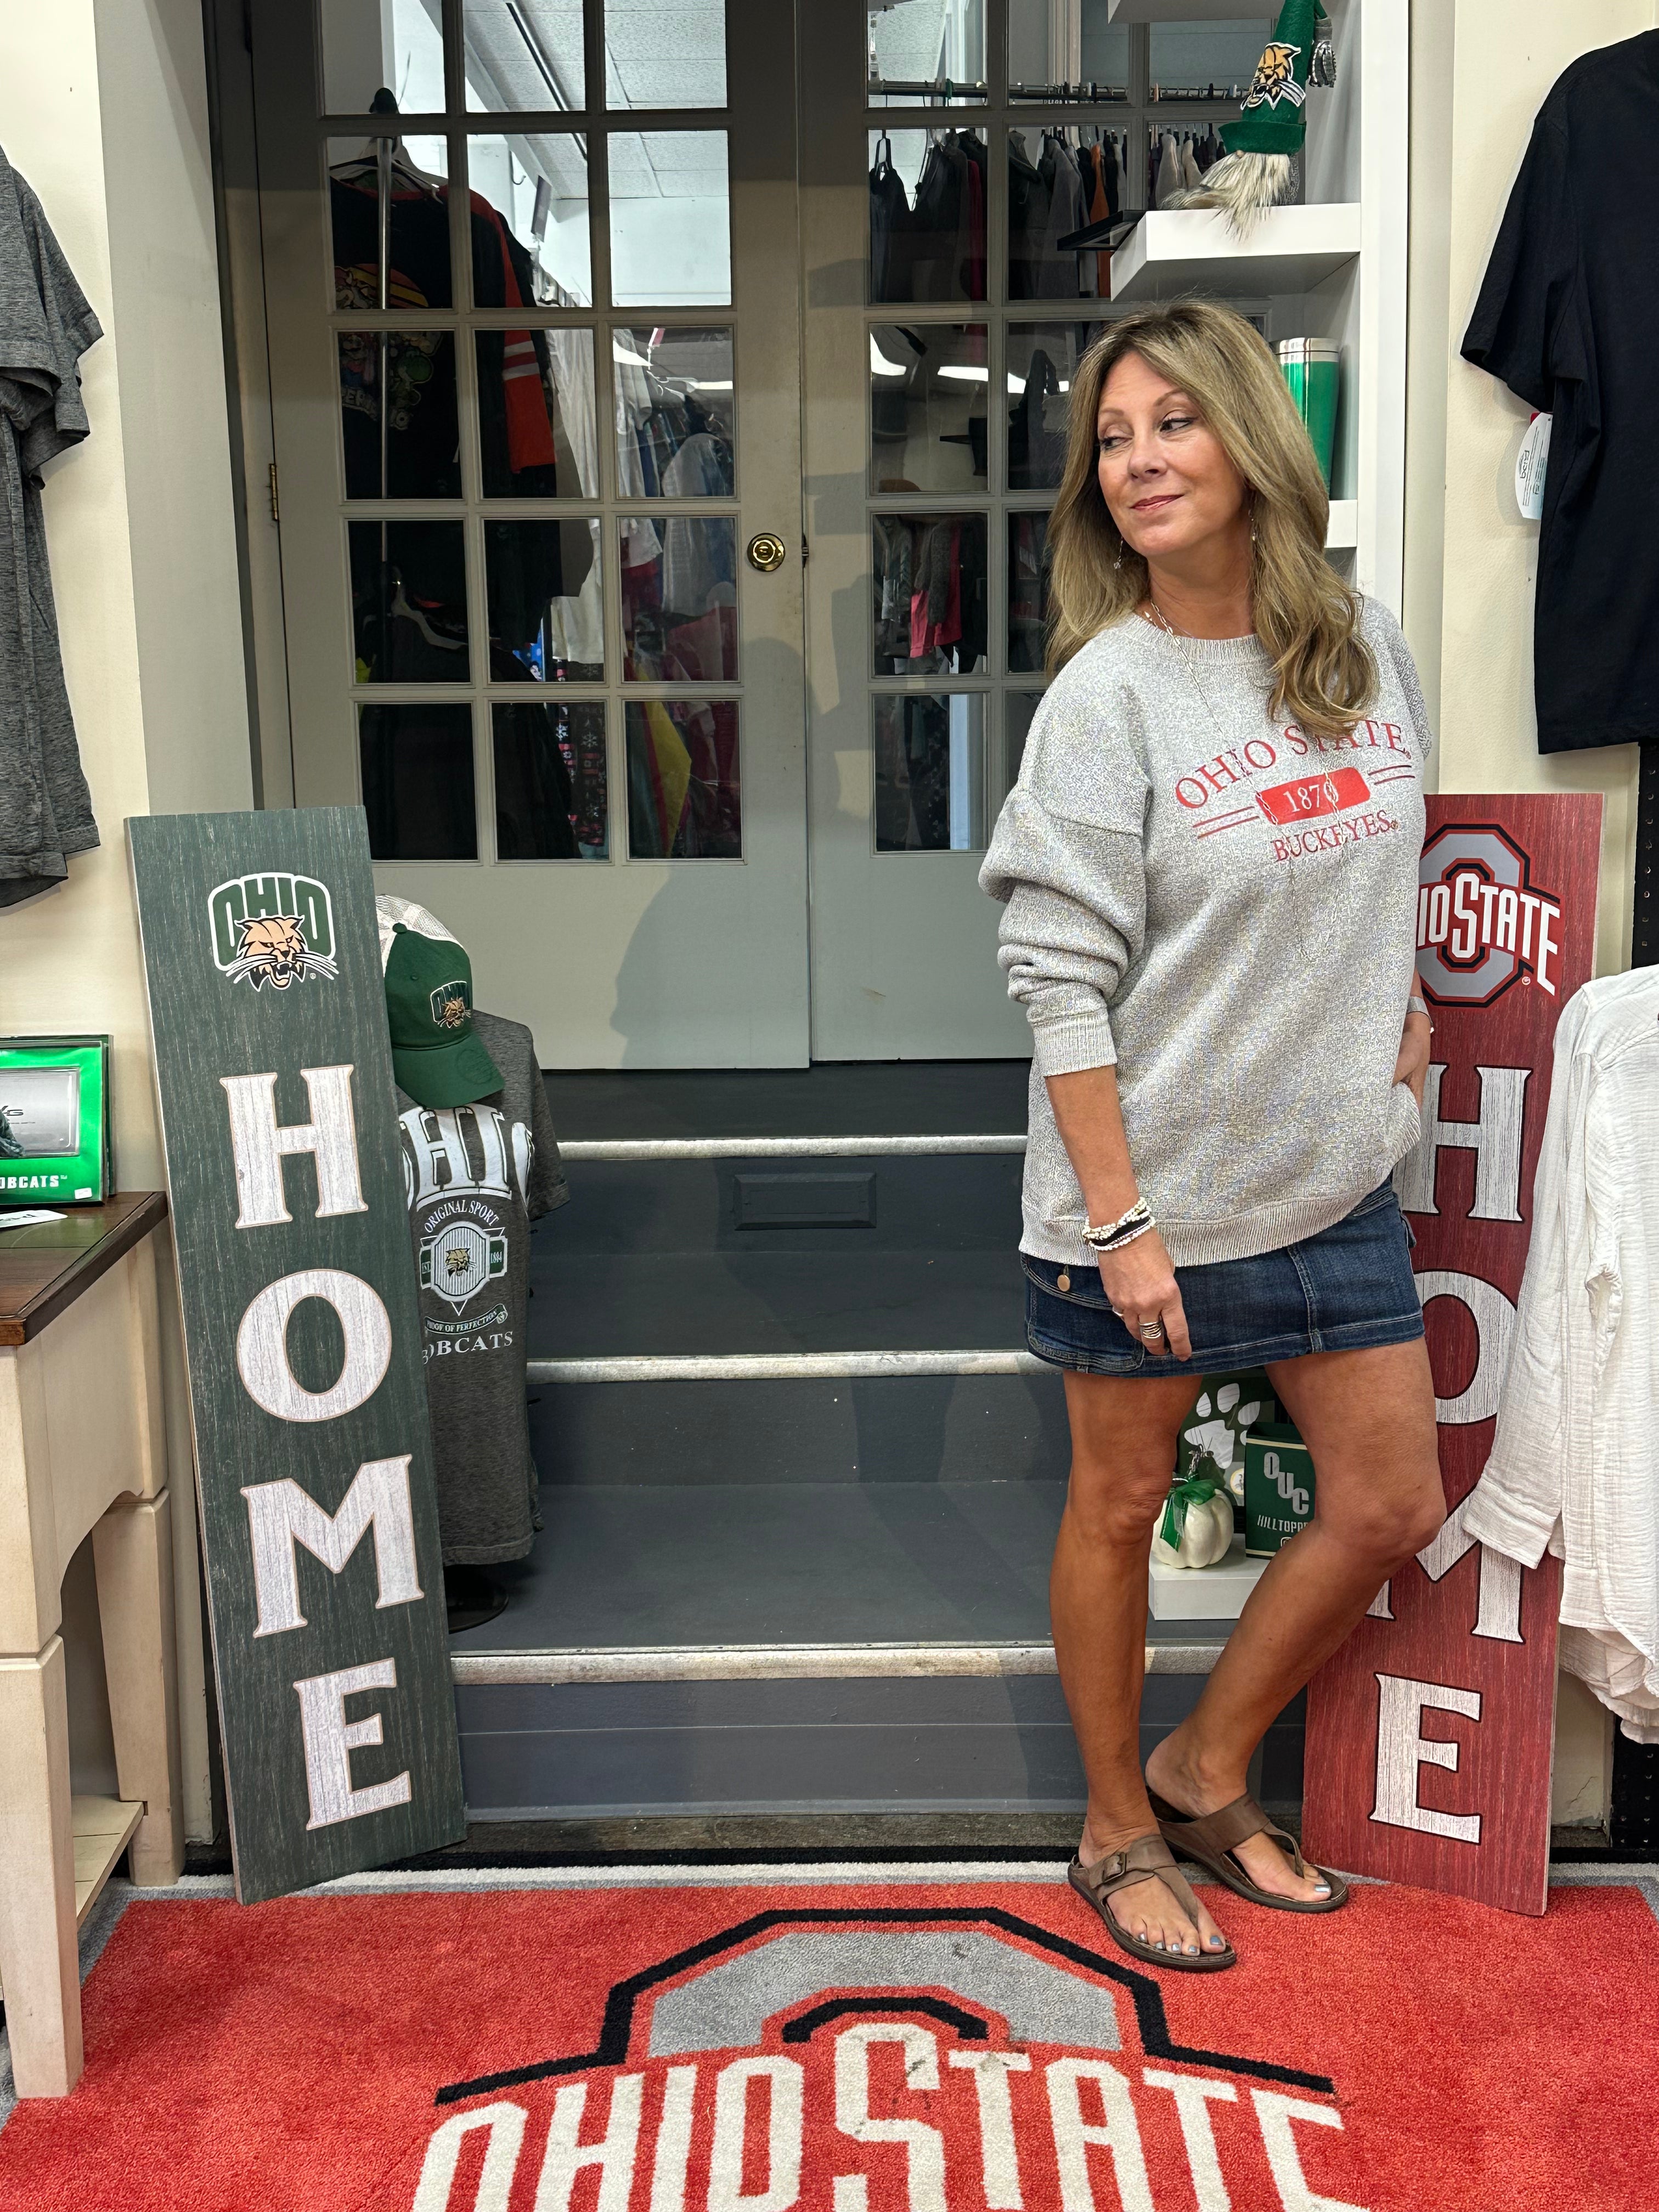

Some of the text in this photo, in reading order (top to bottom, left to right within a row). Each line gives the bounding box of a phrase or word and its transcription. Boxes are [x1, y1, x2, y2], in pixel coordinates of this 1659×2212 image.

[1175, 740, 1277, 809] OHIO
[1282, 782, 1339, 814] 1870
[207, 872, 336, 972] OHIO
[1418, 872, 1561, 997] IO STATE
[0, 1175, 59, 1189] OBCATS
[424, 1199, 500, 1234] ORIGINAL SPORT
[219, 1063, 425, 1831] HOME
[1263, 1452, 1310, 1515] OUC
[1257, 1514, 1308, 1533] HILLTOPP
[413, 2055, 804, 2212] OHIO
